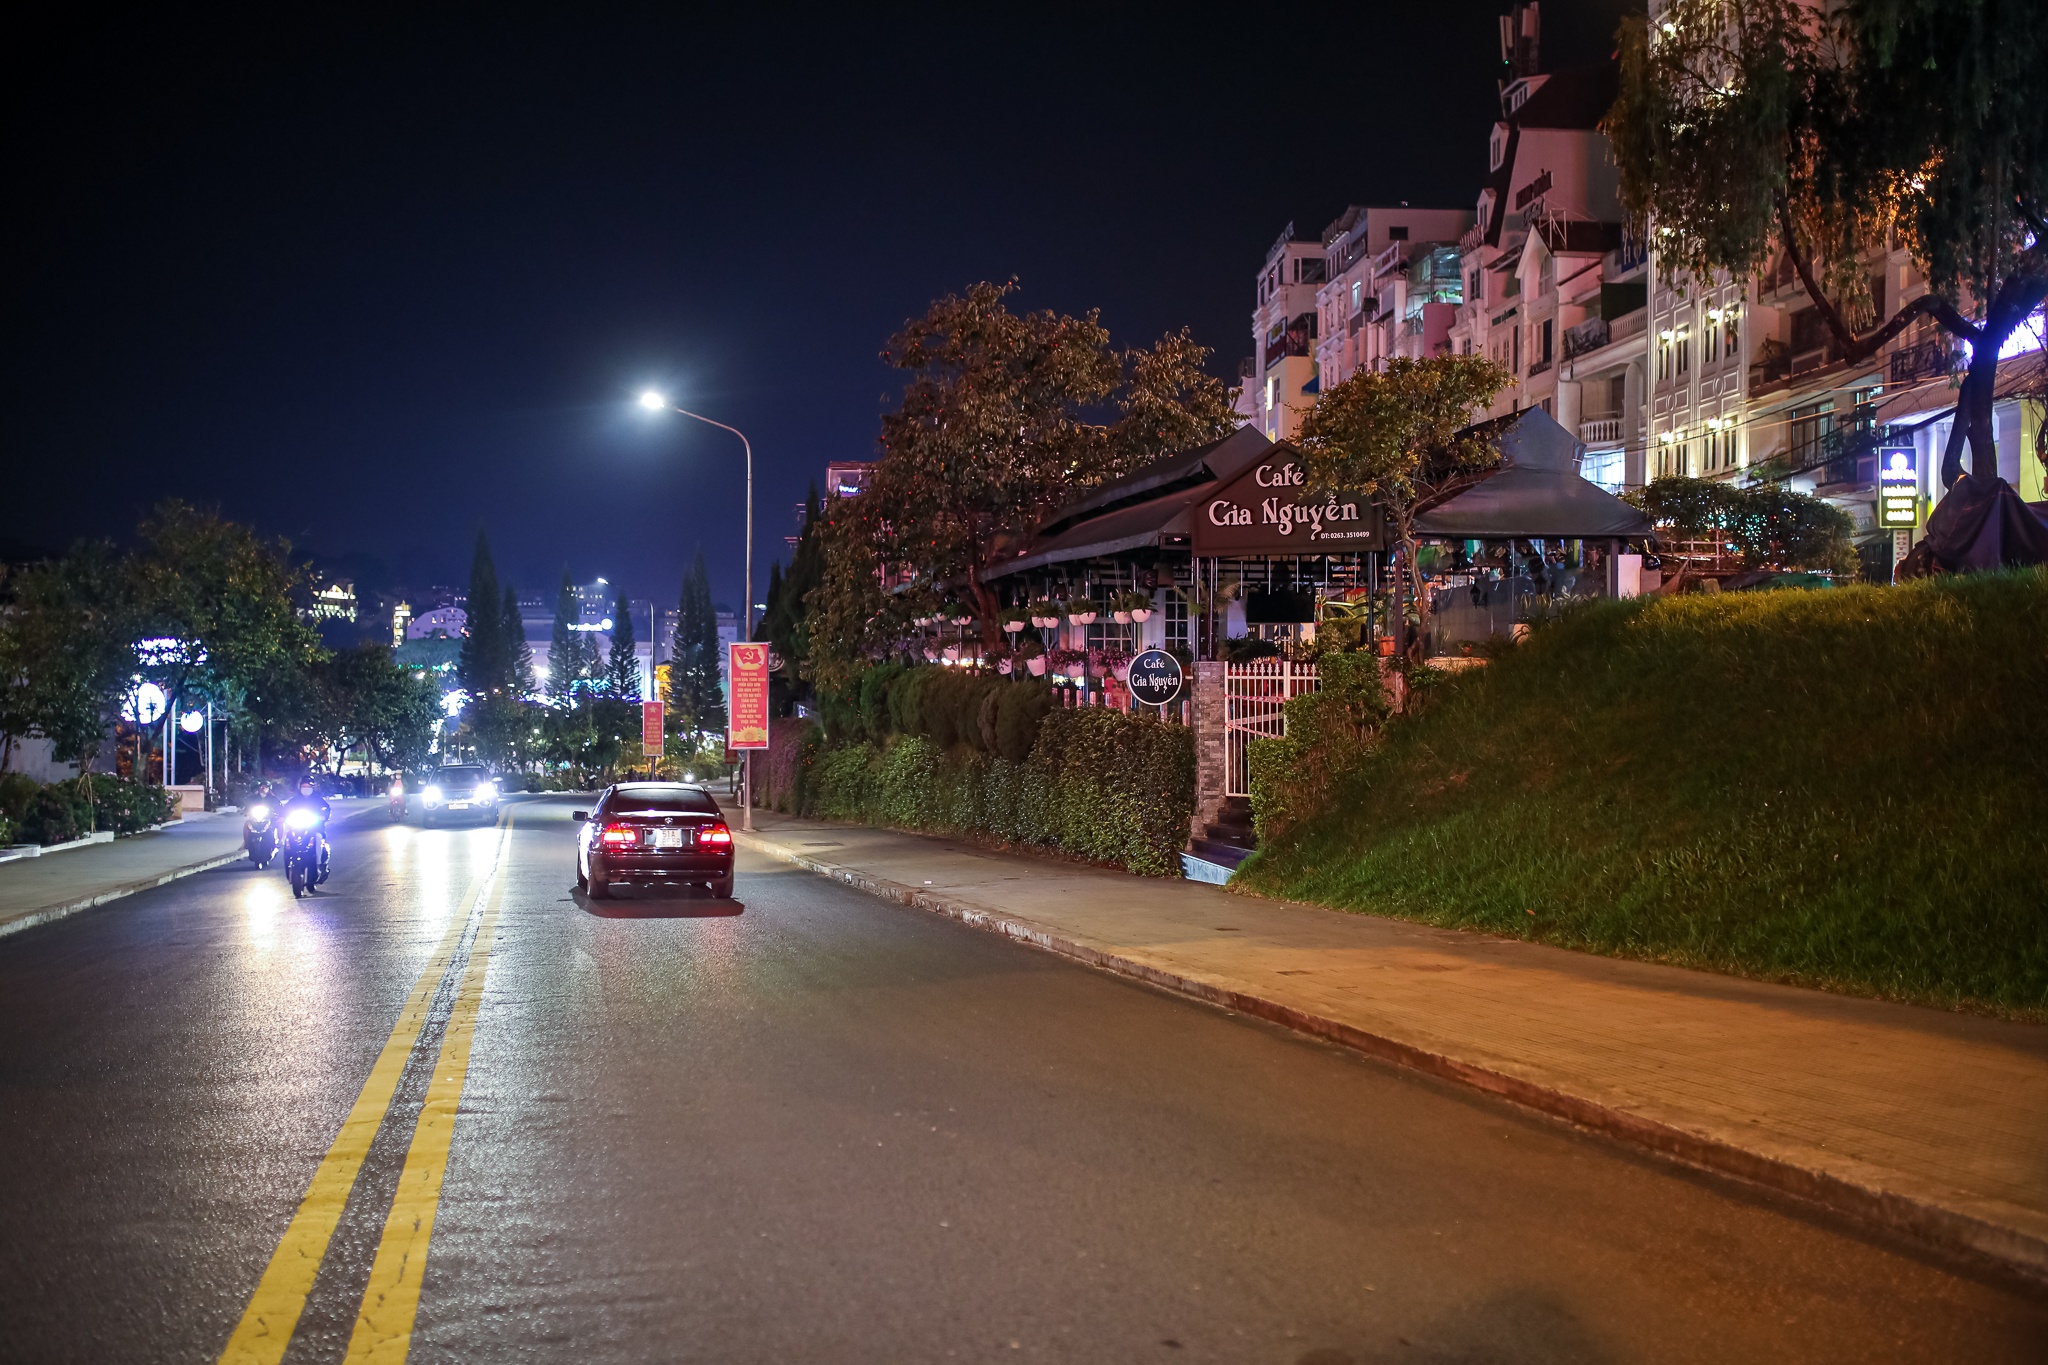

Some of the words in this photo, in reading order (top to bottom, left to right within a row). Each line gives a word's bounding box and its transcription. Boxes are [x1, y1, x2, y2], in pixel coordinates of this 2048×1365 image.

[1256, 462, 1304, 488] Café
[1208, 500, 1253, 526] Gia
[1261, 495, 1359, 540] Nguyễn
[1143, 658, 1165, 669] Café
[1131, 673, 1148, 687] Gia
